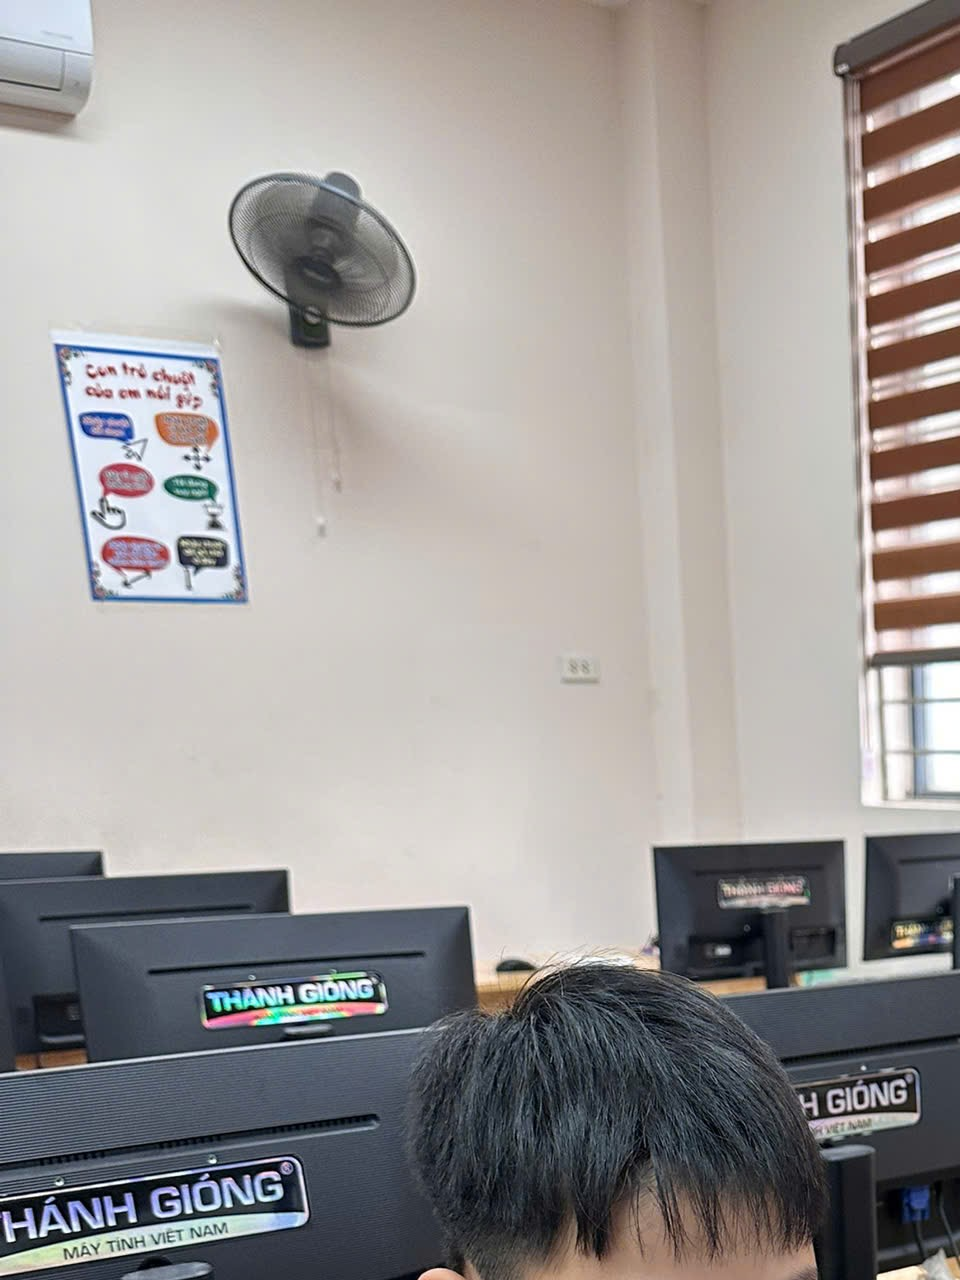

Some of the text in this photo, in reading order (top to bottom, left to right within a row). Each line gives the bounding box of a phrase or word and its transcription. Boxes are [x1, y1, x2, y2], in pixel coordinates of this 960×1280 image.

[0, 1195, 138, 1243] HÁNH
[63, 1221, 229, 1261] MÁY TÍNH VIỆT NAM
